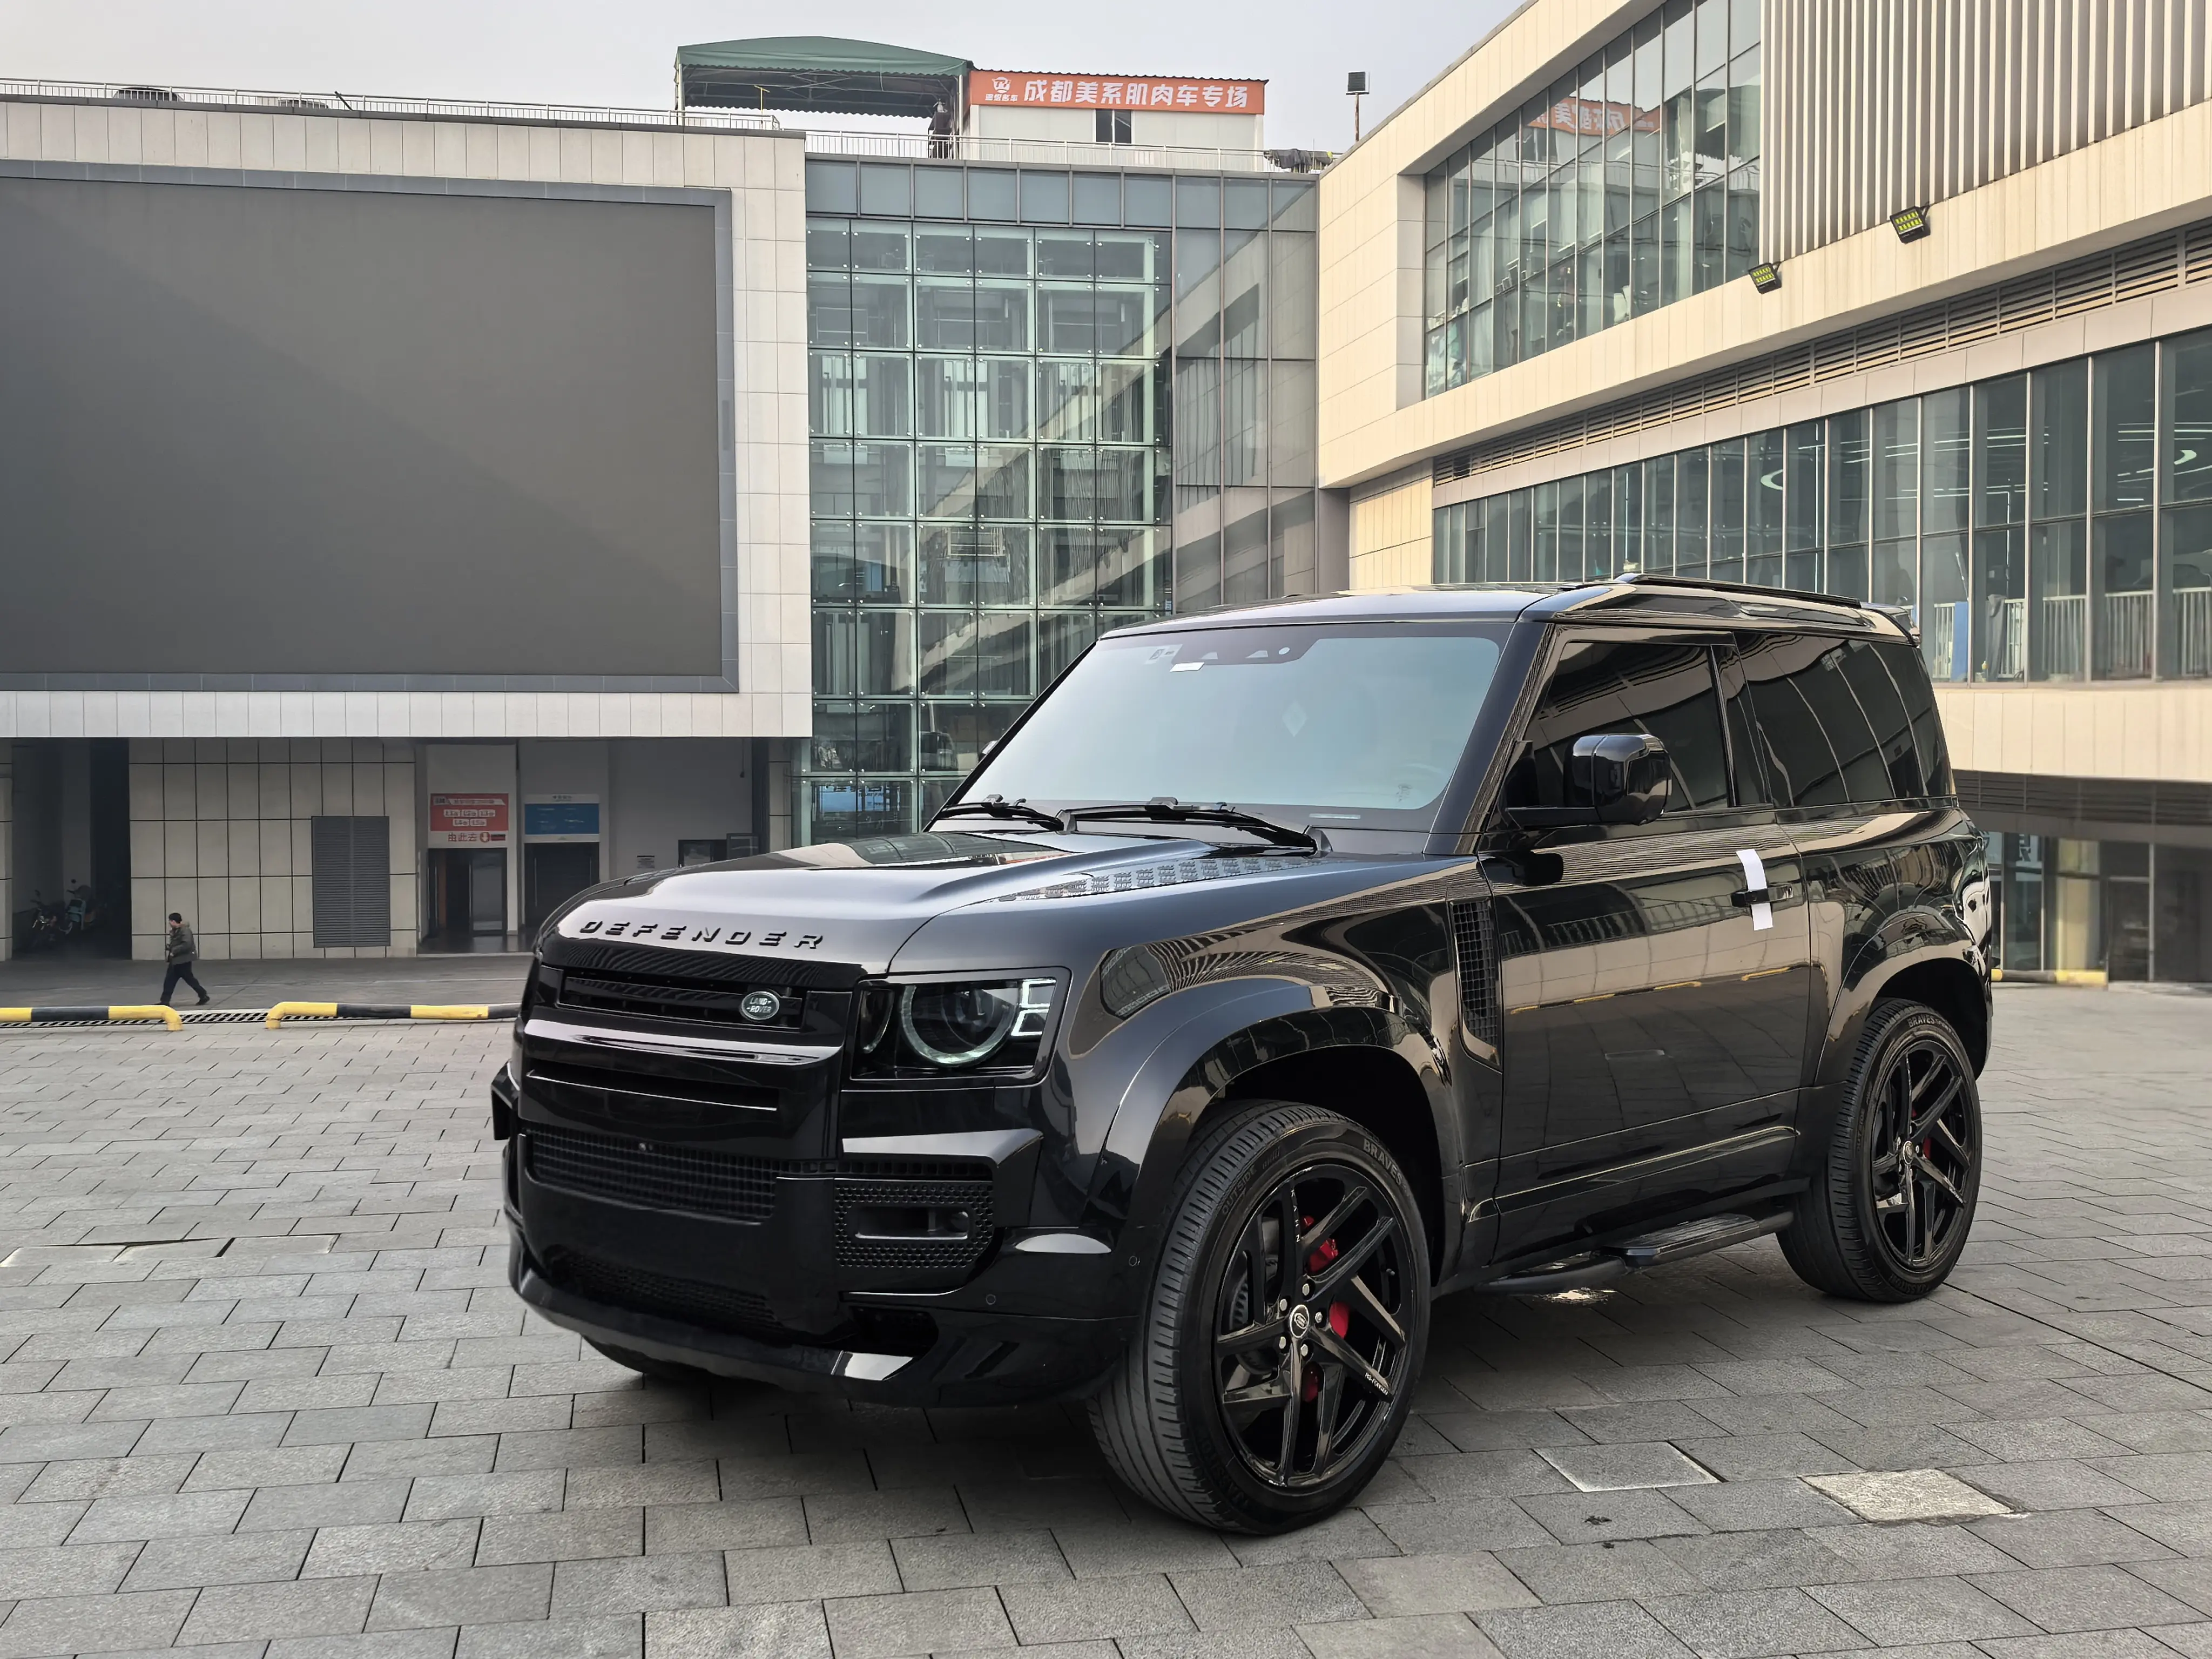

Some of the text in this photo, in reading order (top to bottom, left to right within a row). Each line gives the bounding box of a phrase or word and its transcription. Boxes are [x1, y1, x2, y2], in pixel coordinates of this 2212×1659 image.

[1024, 79, 1248, 108] 成都美系肌肉车专场
[579, 920, 824, 950] DEFENDER
[1907, 1014, 1935, 1028] BRAVES
[1363, 1138, 1403, 1185] BRAVES
[1222, 1164, 1257, 1215] OUTSIDE
